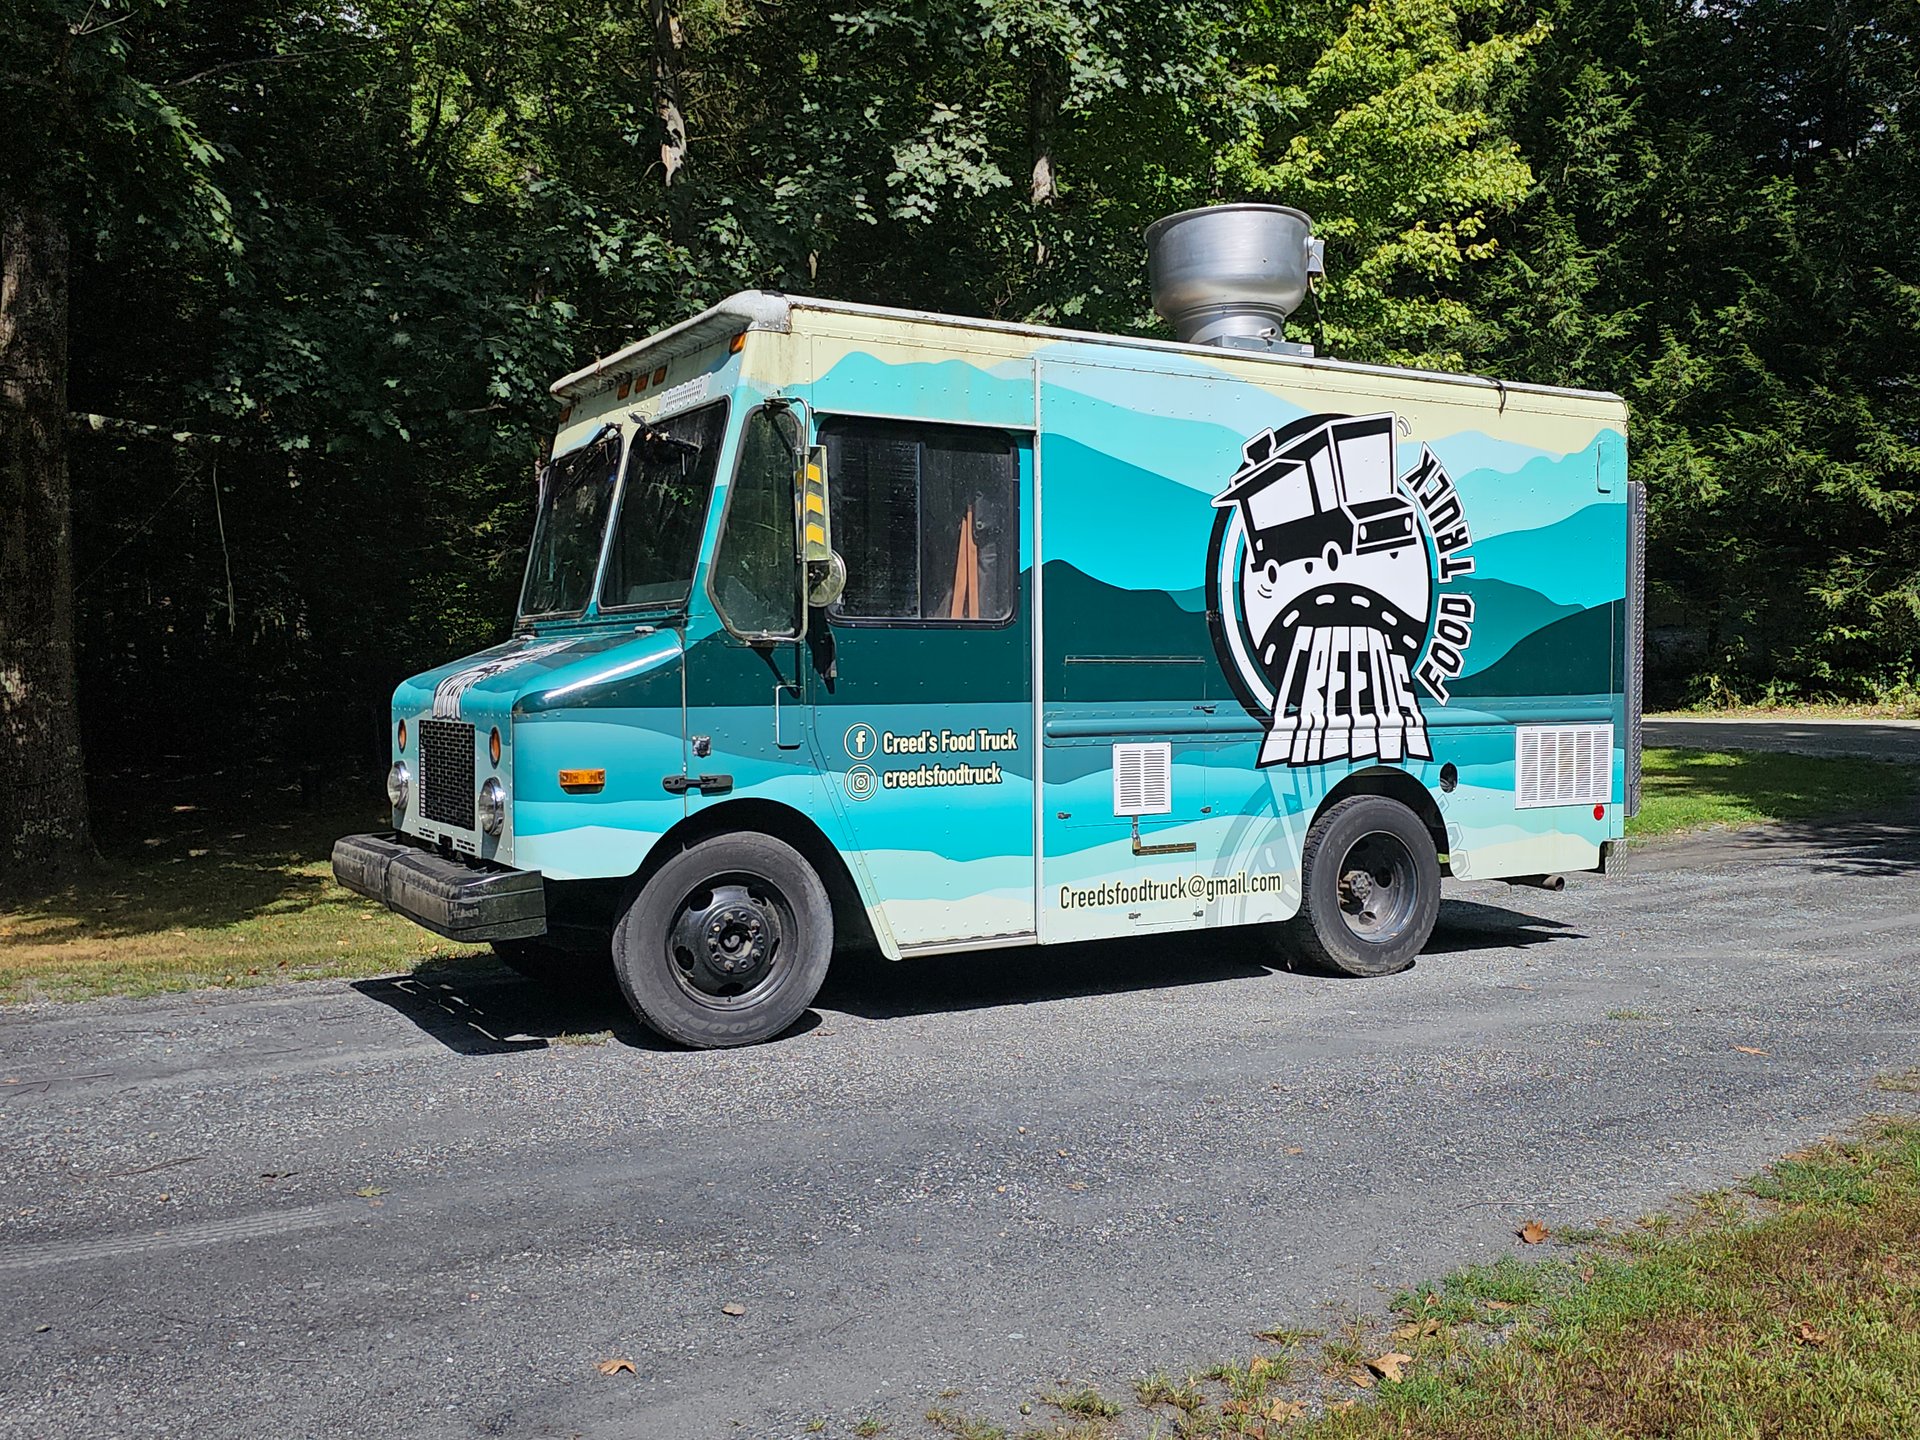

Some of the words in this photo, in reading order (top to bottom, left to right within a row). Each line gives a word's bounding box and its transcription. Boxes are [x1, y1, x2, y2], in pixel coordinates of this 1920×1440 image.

[1401, 443, 1475, 582] TRUCK
[1415, 594, 1476, 705] FOOD
[882, 730, 938, 754] Creed's
[940, 729, 976, 752] Food
[977, 728, 1018, 751] Truck
[882, 762, 1002, 788] creedsfoodtruck
[1059, 872, 1282, 909] Creedsfoodtruck@gmail.com
